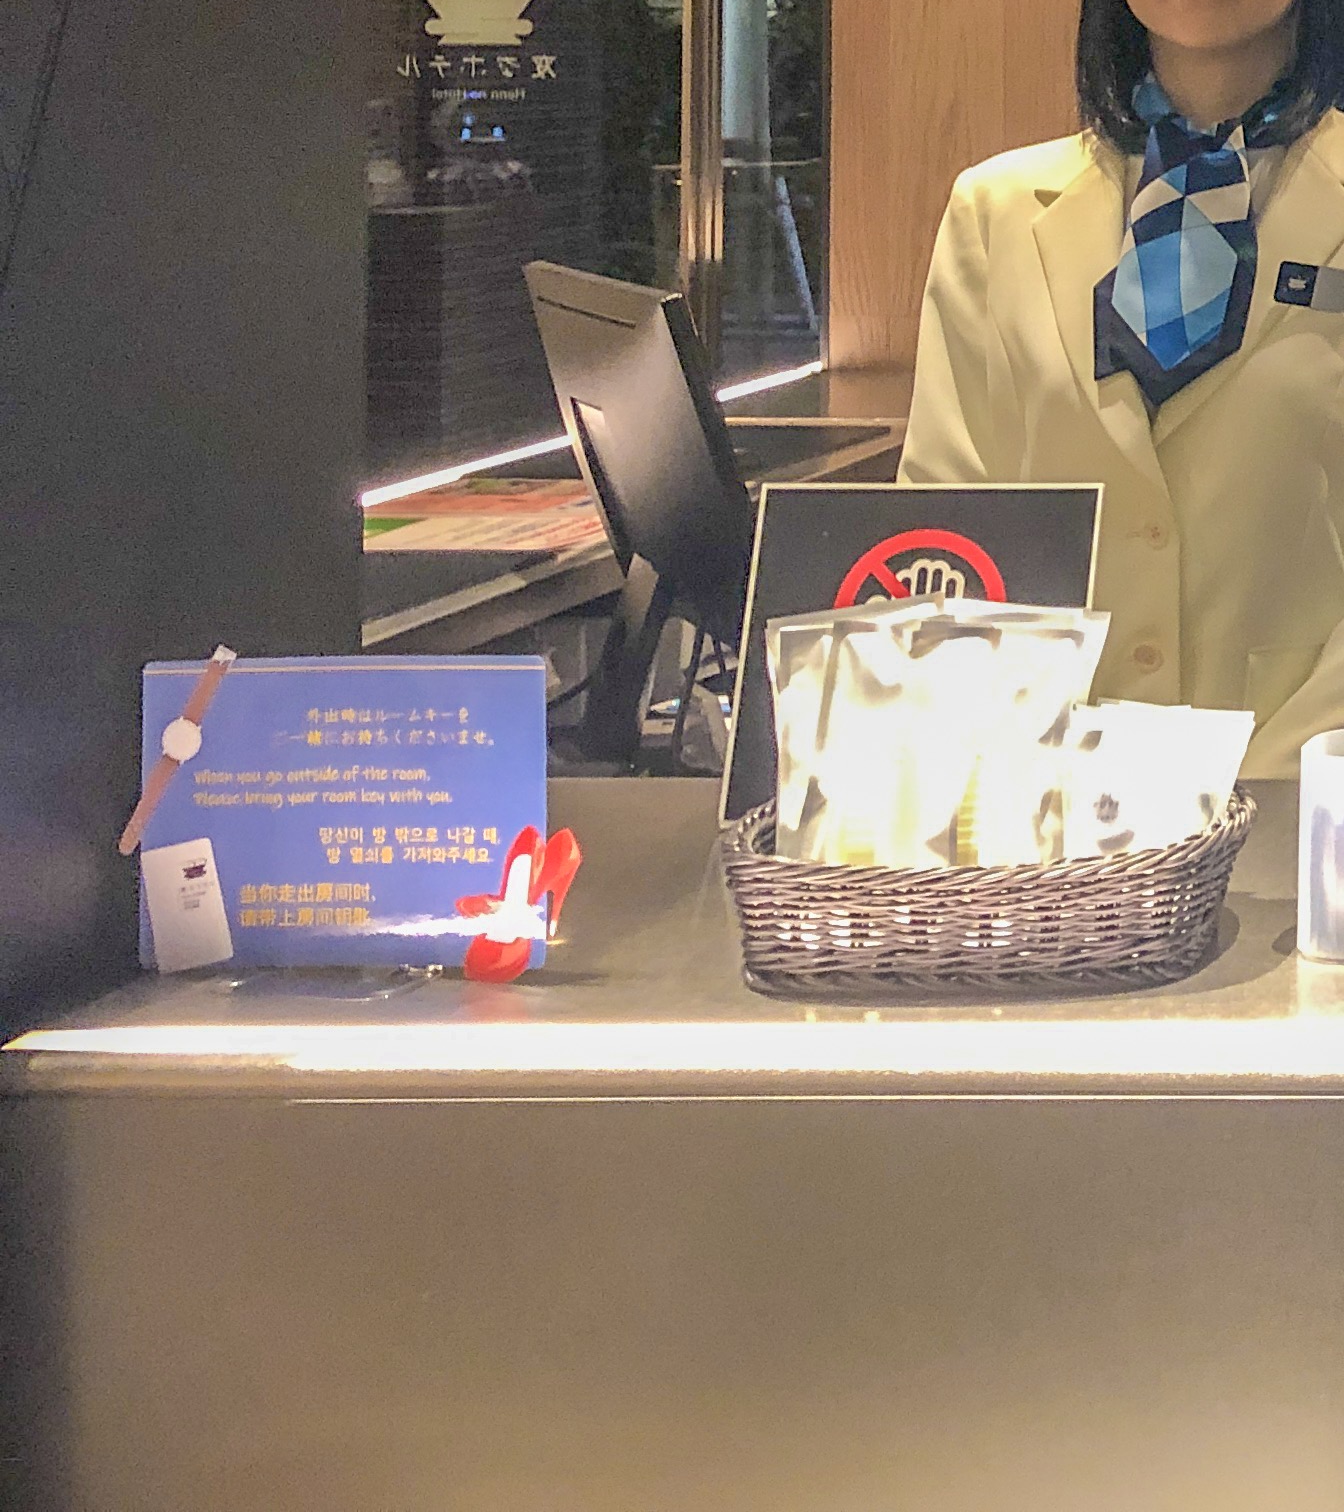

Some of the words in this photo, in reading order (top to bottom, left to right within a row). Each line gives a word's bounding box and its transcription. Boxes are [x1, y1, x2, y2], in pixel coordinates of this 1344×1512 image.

[194, 769, 233, 785] When
[237, 772, 261, 786] you
[266, 770, 283, 786] go
[287, 766, 339, 784] outside
[343, 765, 360, 782] of
[362, 767, 387, 782] the
[287, 791, 318, 806] your
[322, 791, 356, 803] room
[361, 789, 385, 805] key
[388, 787, 422, 802] with
[318, 827, 364, 844] 당신이
[447, 827, 475, 845] 나갈
